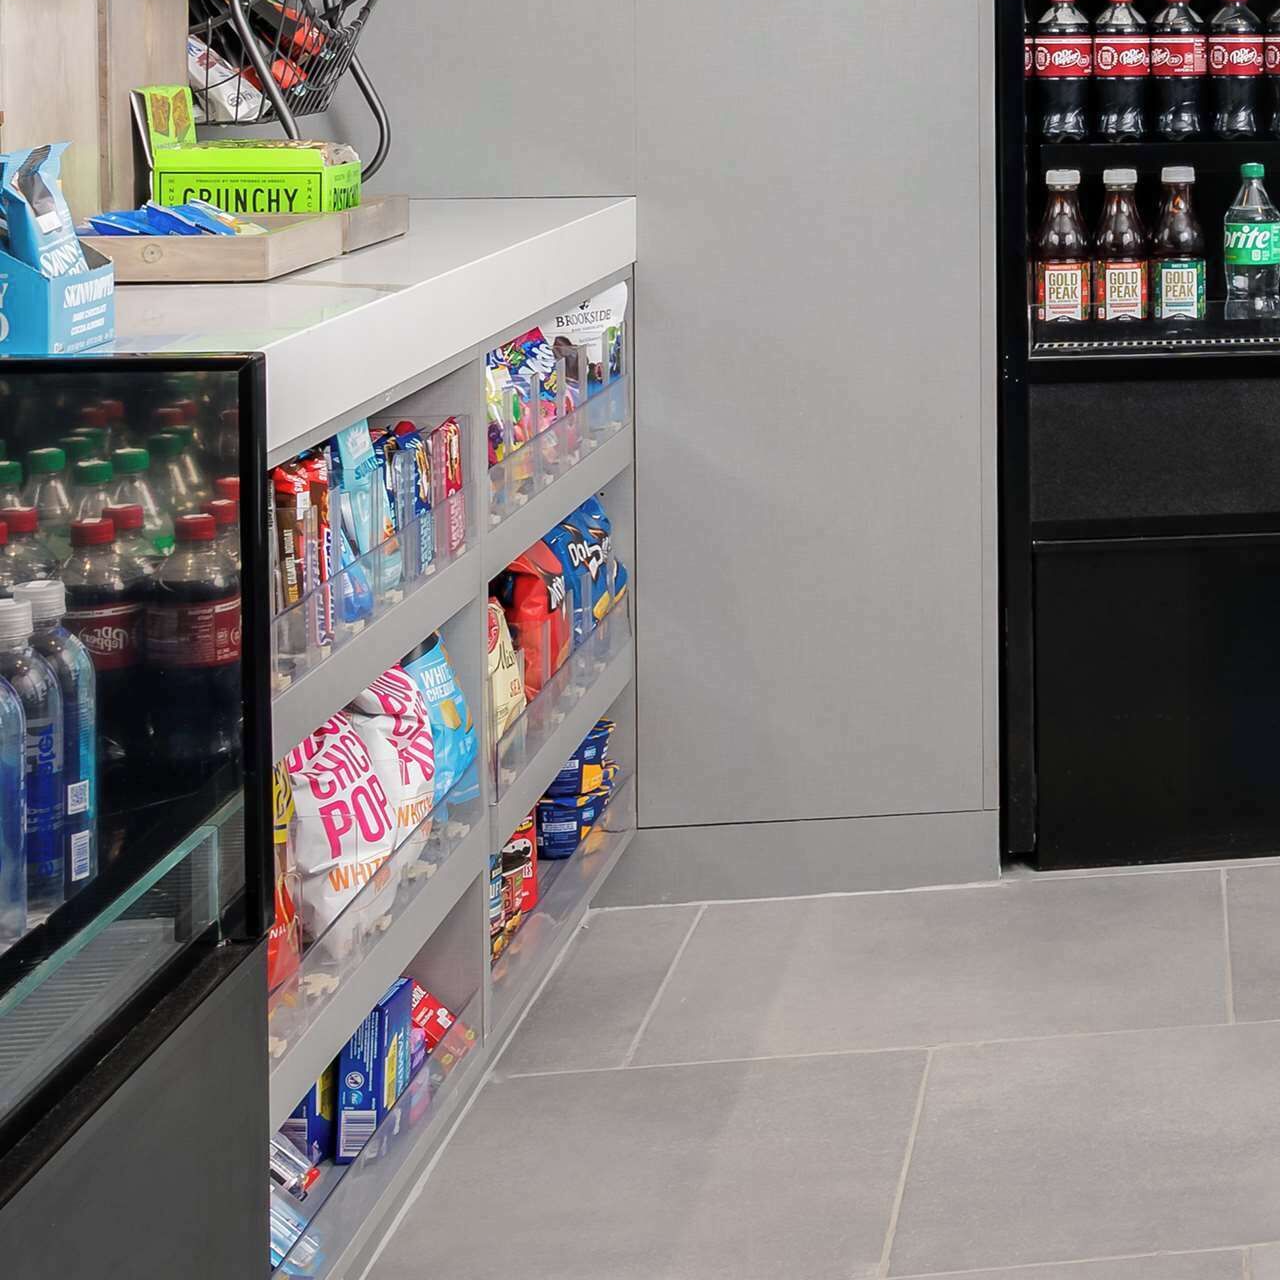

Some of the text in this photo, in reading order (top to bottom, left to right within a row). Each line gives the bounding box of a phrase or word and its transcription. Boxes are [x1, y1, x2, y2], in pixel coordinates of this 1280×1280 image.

[1054, 51, 1080, 65] Pepper
[1063, 48, 1074, 56] Dr
[1121, 51, 1145, 65] Pepper
[1131, 48, 1141, 56] Dr
[1231, 51, 1257, 65] Pepper
[1240, 48, 1250, 56] Dr
[182, 188, 299, 213] CRUNCHY
[1050, 272, 1077, 286] GOLD
[1109, 271, 1138, 285] GOLD
[1165, 271, 1194, 285] GOLD
[1050, 286, 1079, 299] PEAK
[1109, 285, 1138, 298] PEAK
[1165, 285, 1194, 298] PEAK
[555, 309, 612, 328] BROOKSIDE
[318, 774, 393, 860] POP
